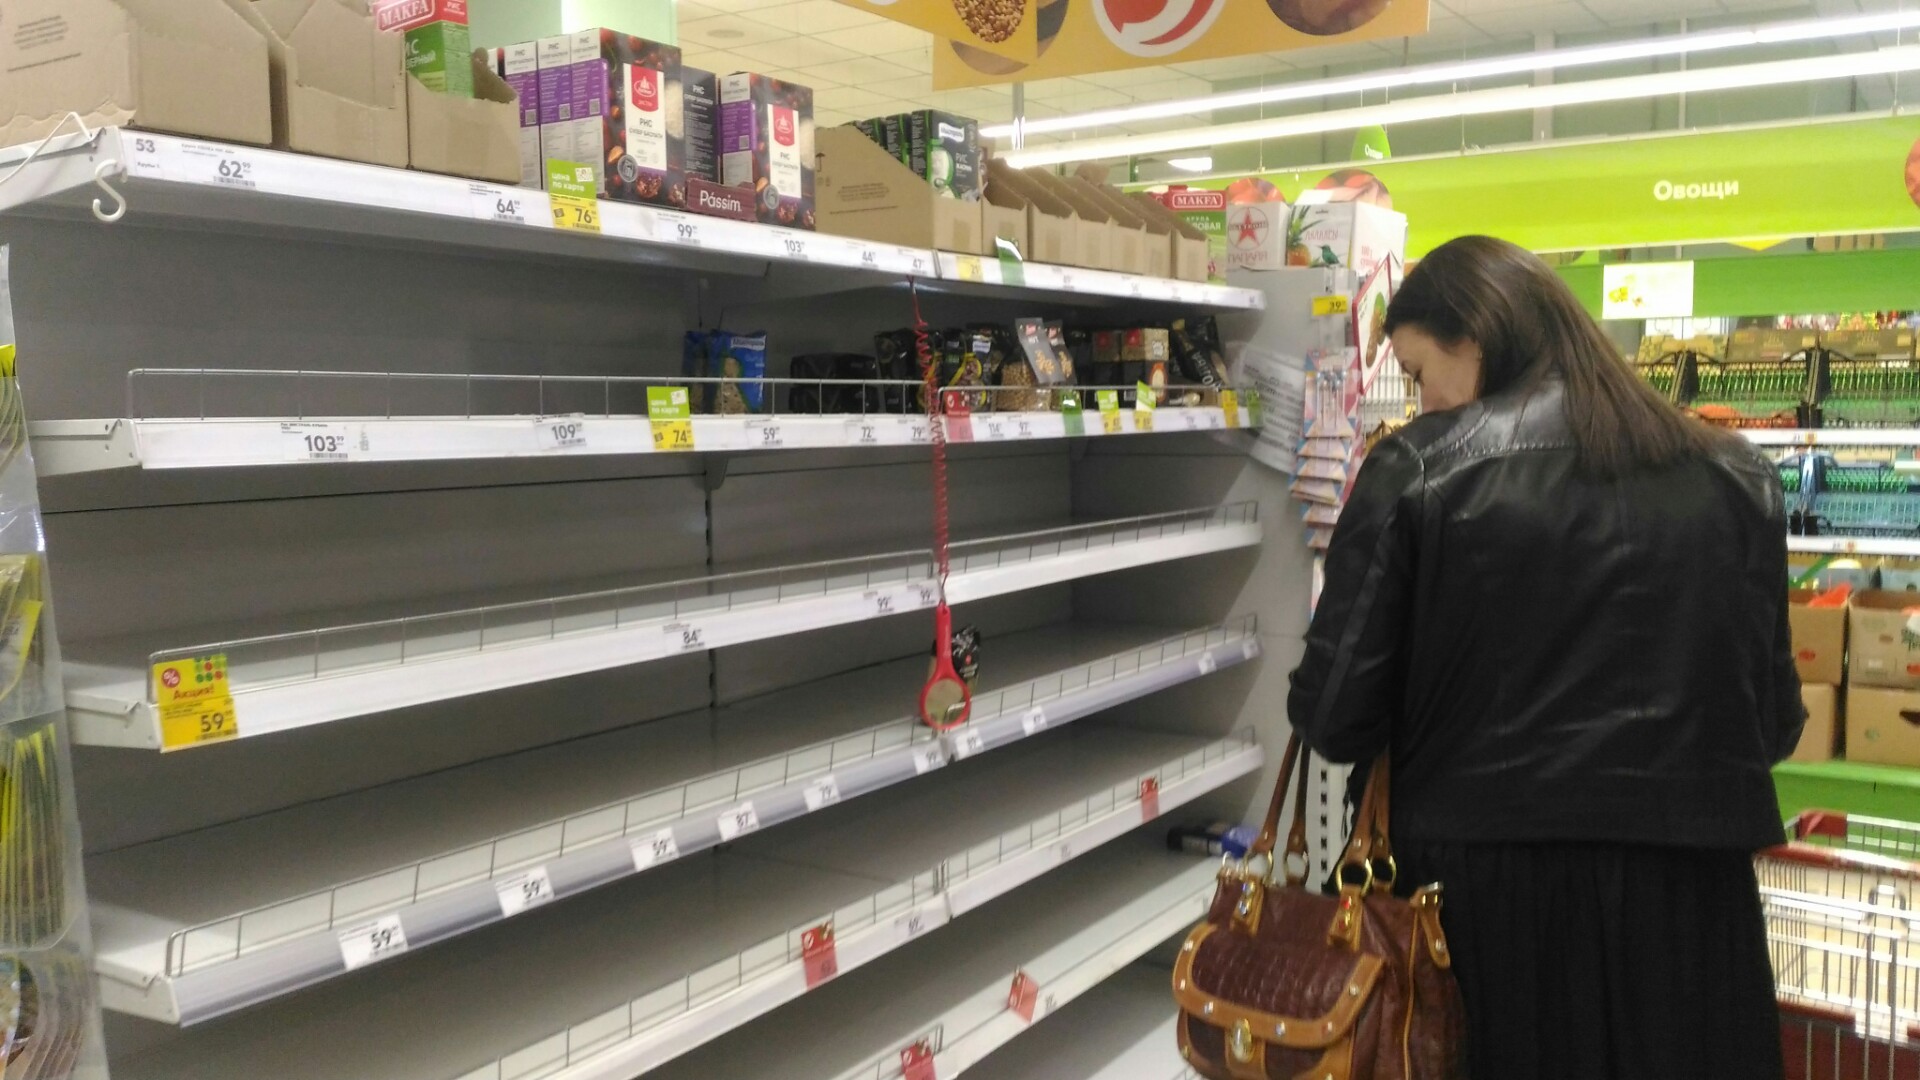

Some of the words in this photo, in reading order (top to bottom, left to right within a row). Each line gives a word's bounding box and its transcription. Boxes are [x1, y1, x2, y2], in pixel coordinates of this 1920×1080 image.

[381, 0, 430, 28] MAKFA
[136, 138, 155, 153] 53
[218, 160, 243, 178] 62
[1653, 180, 1739, 201] Овощи
[496, 199, 515, 214] 64
[1177, 196, 1218, 205] MAKFA
[575, 208, 592, 223] 76
[678, 224, 693, 237] 99
[785, 240, 802, 253] 103
[552, 424, 576, 440] 109
[673, 430, 687, 442] 74
[763, 427, 775, 440] 59
[304, 435, 337, 452] 103
[683, 631, 698, 643] 84
[201, 712, 224, 733] 59
[523, 880, 540, 899] 59
[371, 928, 391, 949] 59
